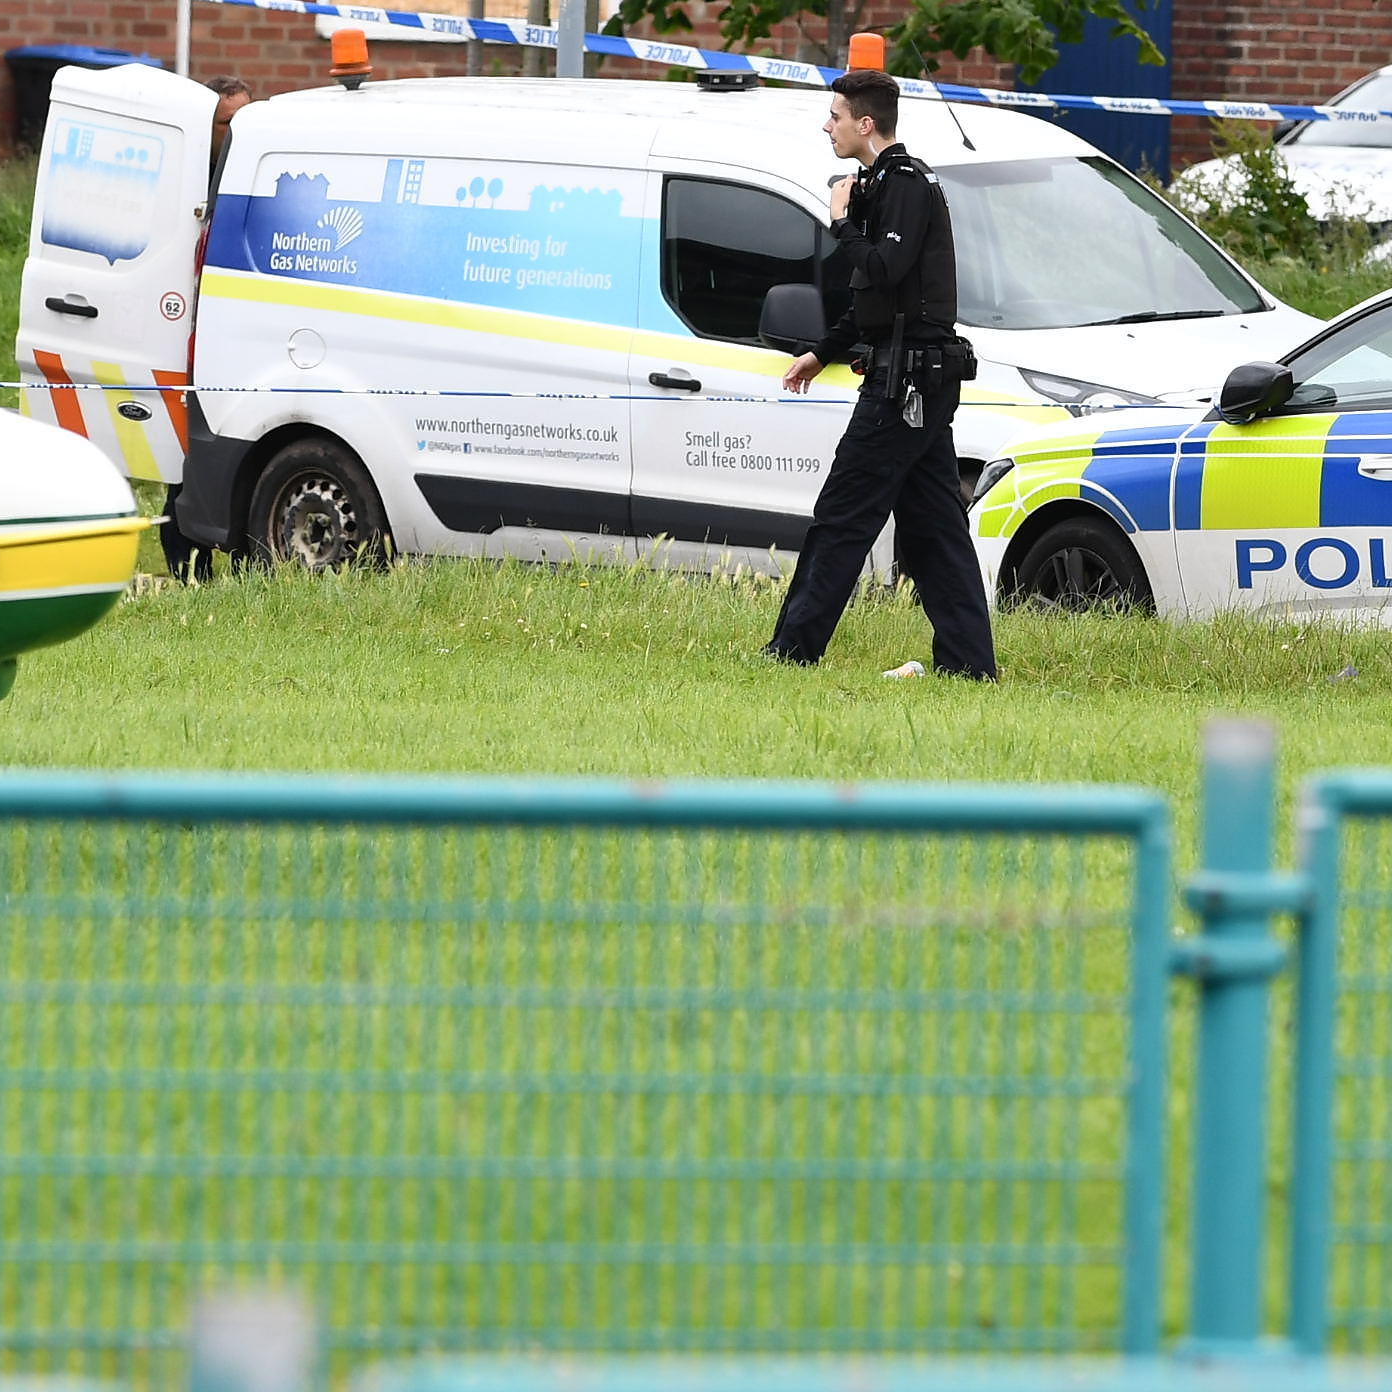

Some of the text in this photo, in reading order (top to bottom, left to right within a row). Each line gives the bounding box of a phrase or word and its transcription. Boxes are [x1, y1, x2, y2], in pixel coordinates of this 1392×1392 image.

[525, 28, 558, 45] OLICE
[646, 45, 691, 63] POLICE
[765, 61, 810, 80] POLICE
[272, 232, 331, 253] Northern
[466, 232, 566, 261] Investing for
[270, 253, 358, 274] Gas Networks
[463, 260, 613, 290] future generations
[165, 301, 180, 312] 62
[415, 417, 619, 443] www.northerngasnetworks.co.uk
[685, 431, 752, 453] Smell gas?
[474, 444, 620, 462] www.facebook.com/northerngasnetworks
[686, 450, 821, 473] Call free 0800 111 999
